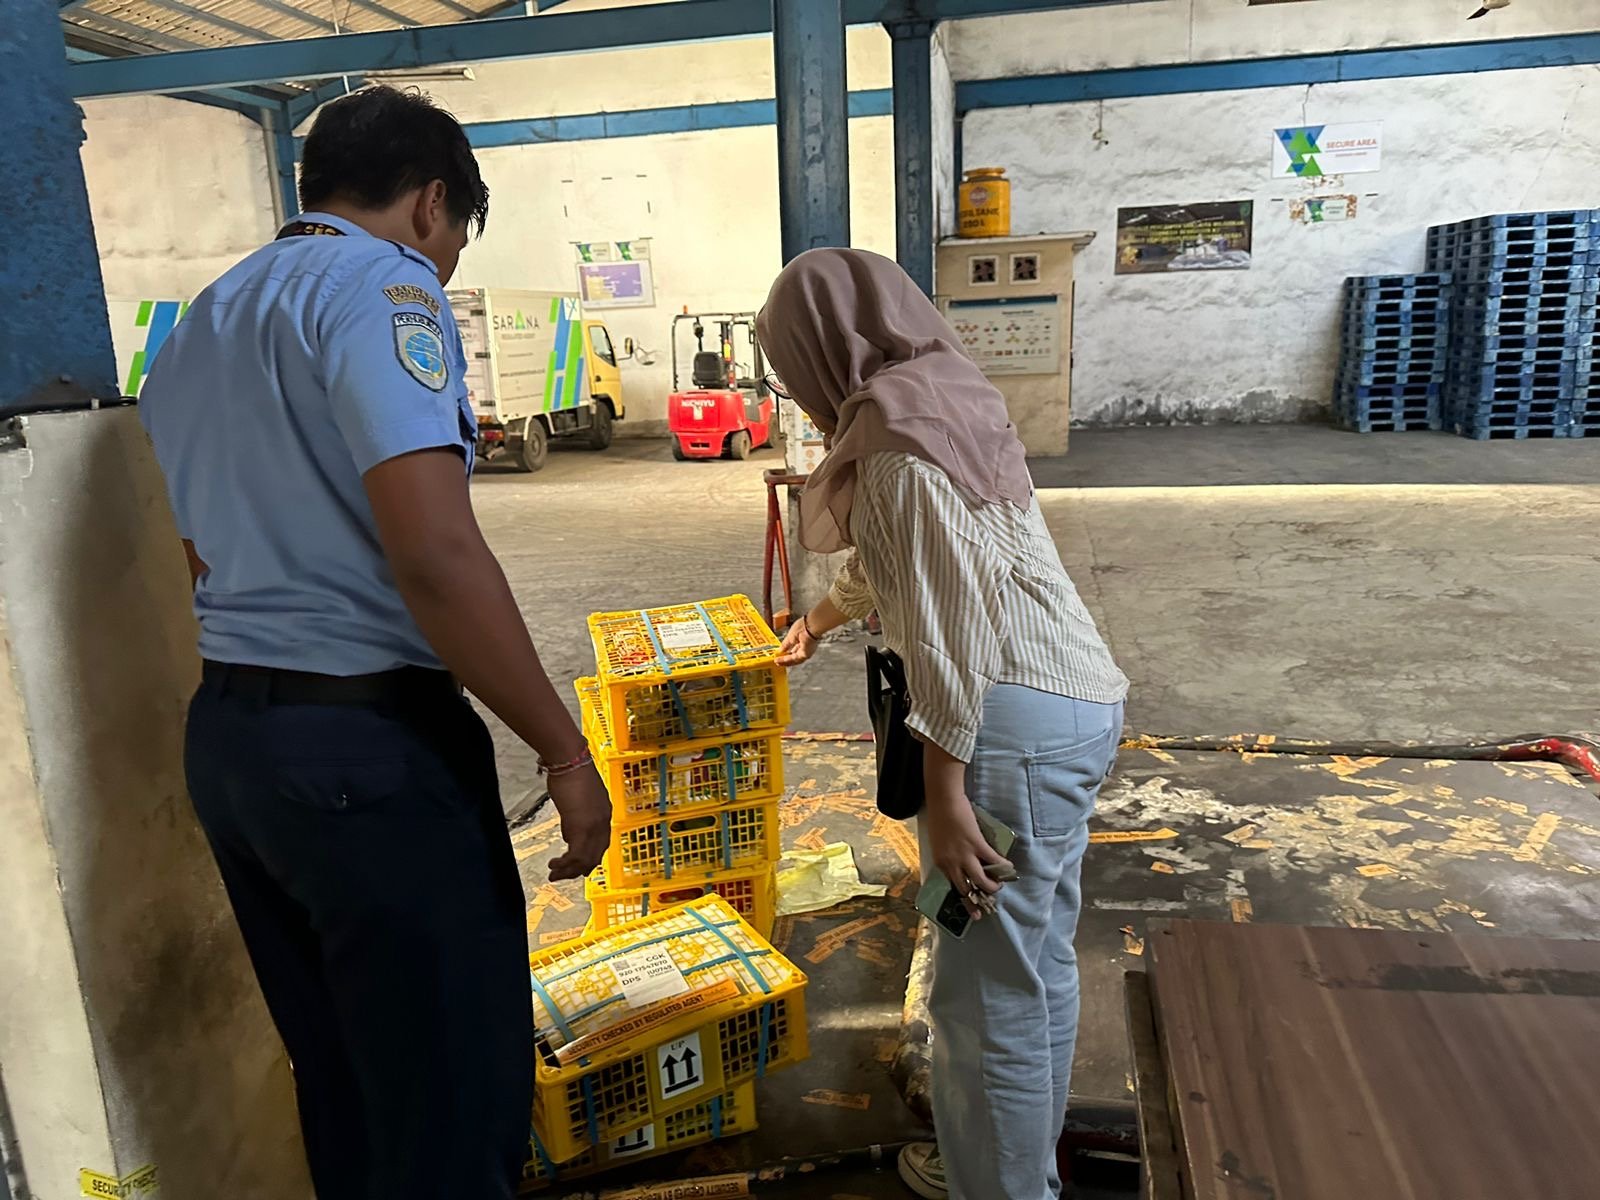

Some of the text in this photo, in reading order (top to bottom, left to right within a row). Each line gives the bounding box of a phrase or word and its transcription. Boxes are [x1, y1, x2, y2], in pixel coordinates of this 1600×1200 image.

[1326, 138, 1377, 149] SECURE AREA
[493, 308, 540, 330] SARANA
[645, 953, 666, 962] CGK
[621, 975, 642, 986] DPS
[565, 995, 705, 1056] SECURITY CHECKED BY REGULATED AGENT
